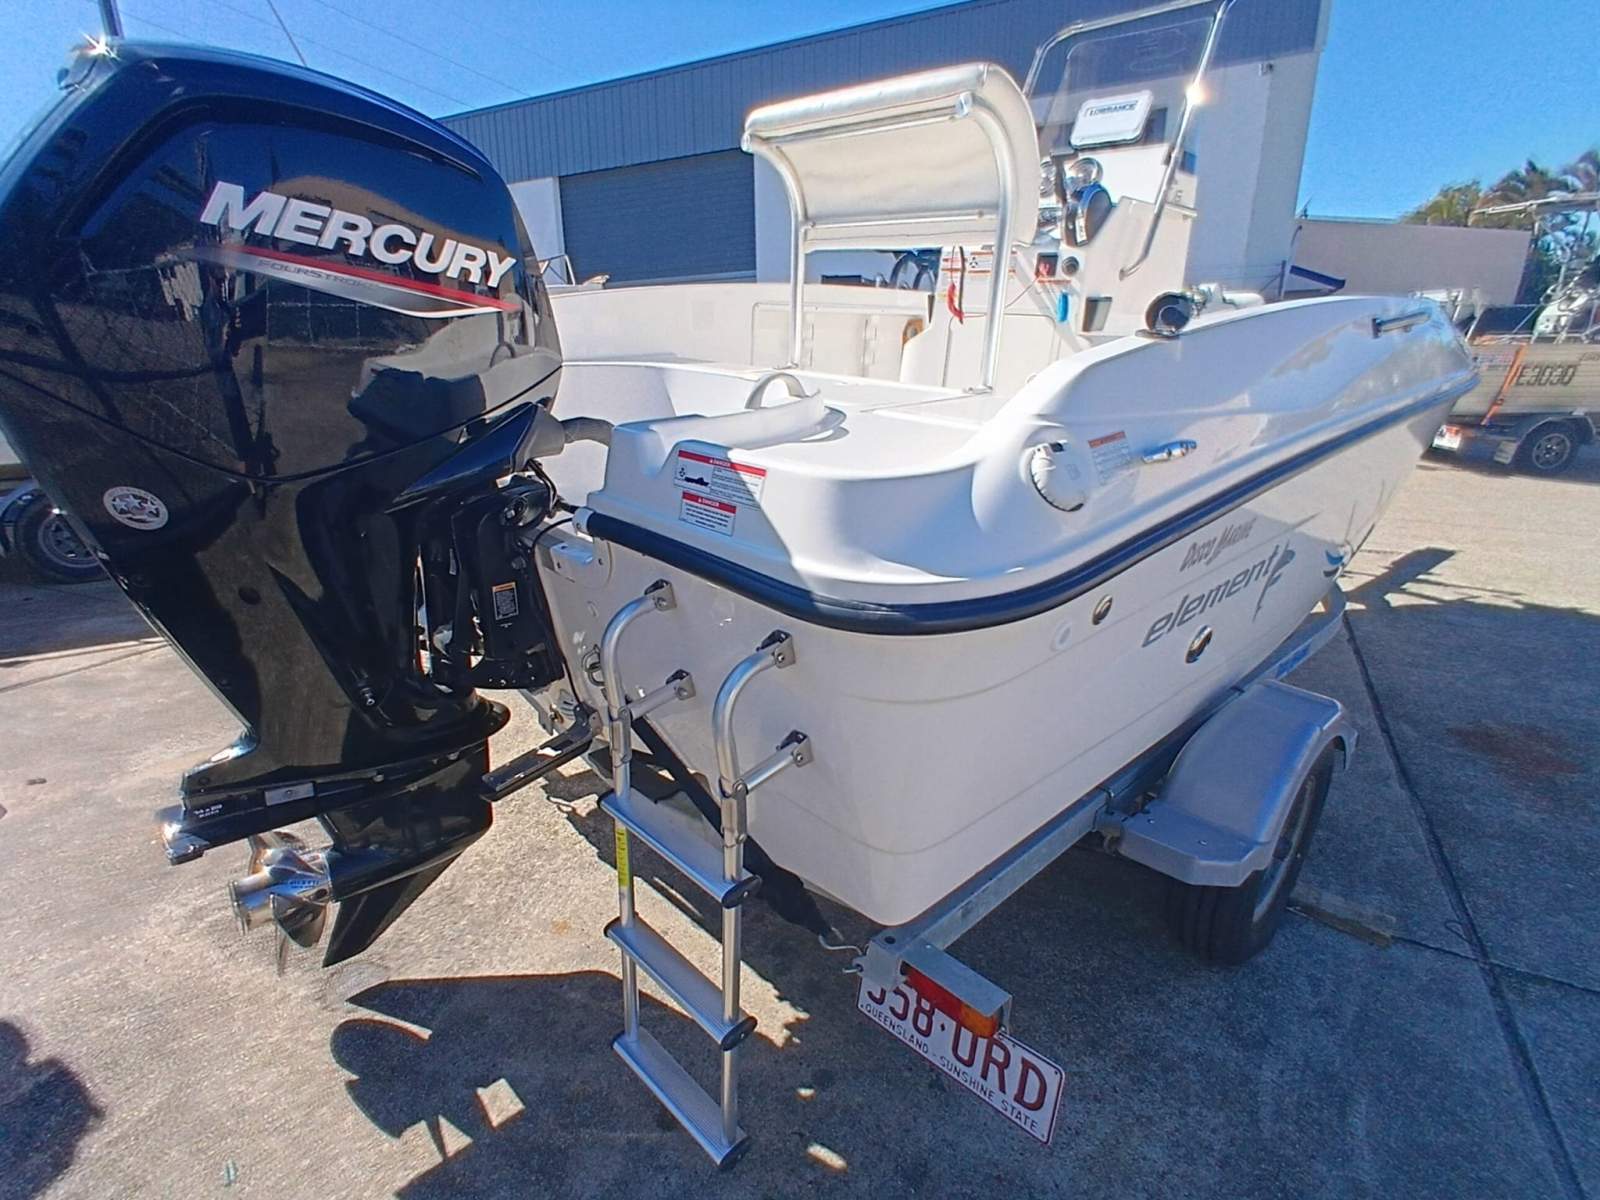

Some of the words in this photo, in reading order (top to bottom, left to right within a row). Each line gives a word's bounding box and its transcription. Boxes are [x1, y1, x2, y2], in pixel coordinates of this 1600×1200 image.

[200, 181, 517, 289] MERCURY
[1142, 544, 1280, 648] element
[865, 1003, 929, 1055] QUEENSLAND
[939, 1056, 996, 1102] SUNSHINE
[1001, 1094, 1039, 1134] STATE
